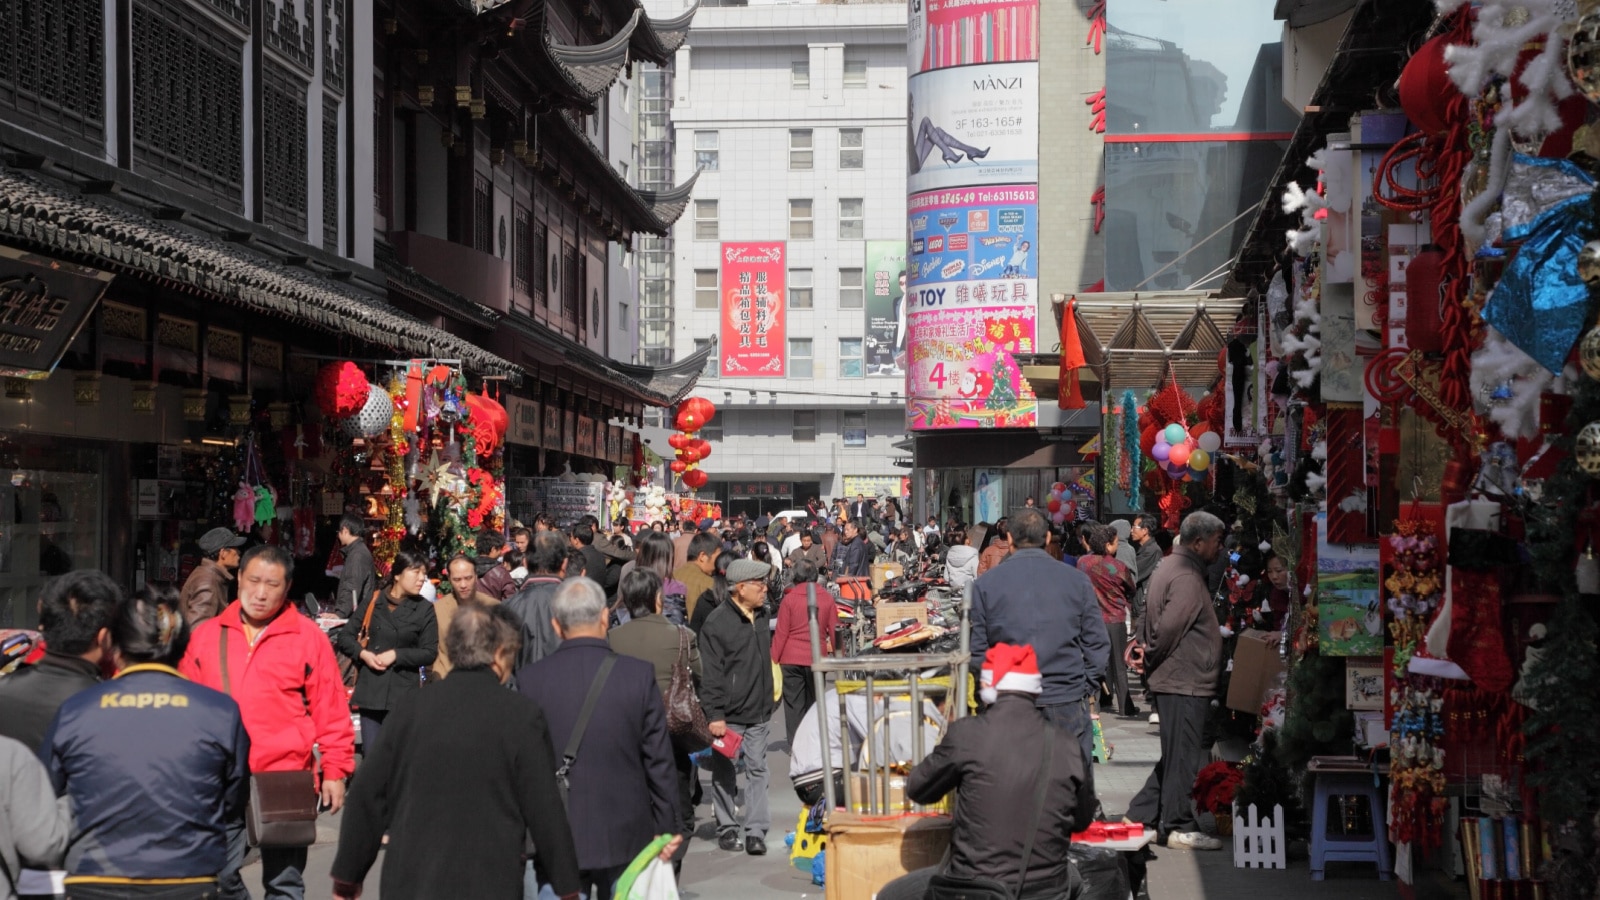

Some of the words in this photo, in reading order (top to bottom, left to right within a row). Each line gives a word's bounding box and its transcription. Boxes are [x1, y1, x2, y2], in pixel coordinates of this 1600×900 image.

[955, 119, 968, 130] 3F
[971, 116, 1023, 129] 163-165#
[978, 190, 1035, 202] Tel:63115613
[929, 239, 942, 249] LEGO
[920, 288, 946, 307] TOY
[739, 271, 751, 347] 精品箱包皮具
[755, 271, 767, 347] 服装辅料皮毛
[929, 362, 960, 390] 4楼
[100, 692, 188, 708] Kappa
